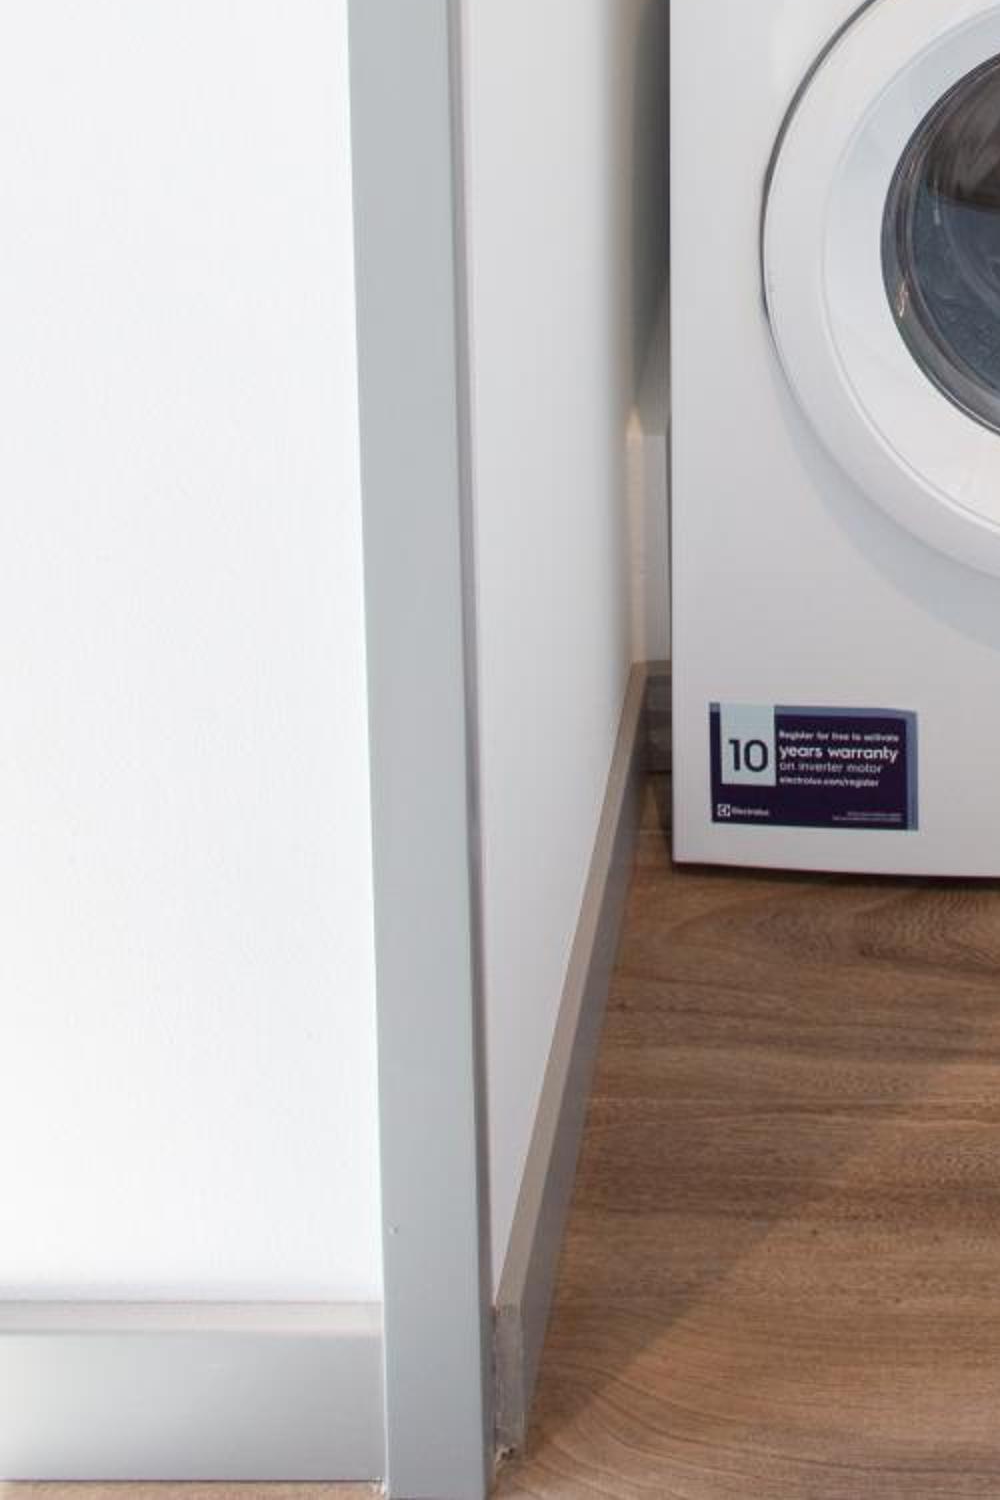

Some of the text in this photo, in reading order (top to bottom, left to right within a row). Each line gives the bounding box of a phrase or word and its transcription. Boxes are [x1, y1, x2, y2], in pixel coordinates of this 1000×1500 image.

[779, 731, 899, 742] Register for free to activate
[729, 739, 769, 772] 10
[779, 746, 899, 764] years warranty
[779, 762, 882, 773] on inverter motor
[779, 777, 880, 788] electrolux.com/register
